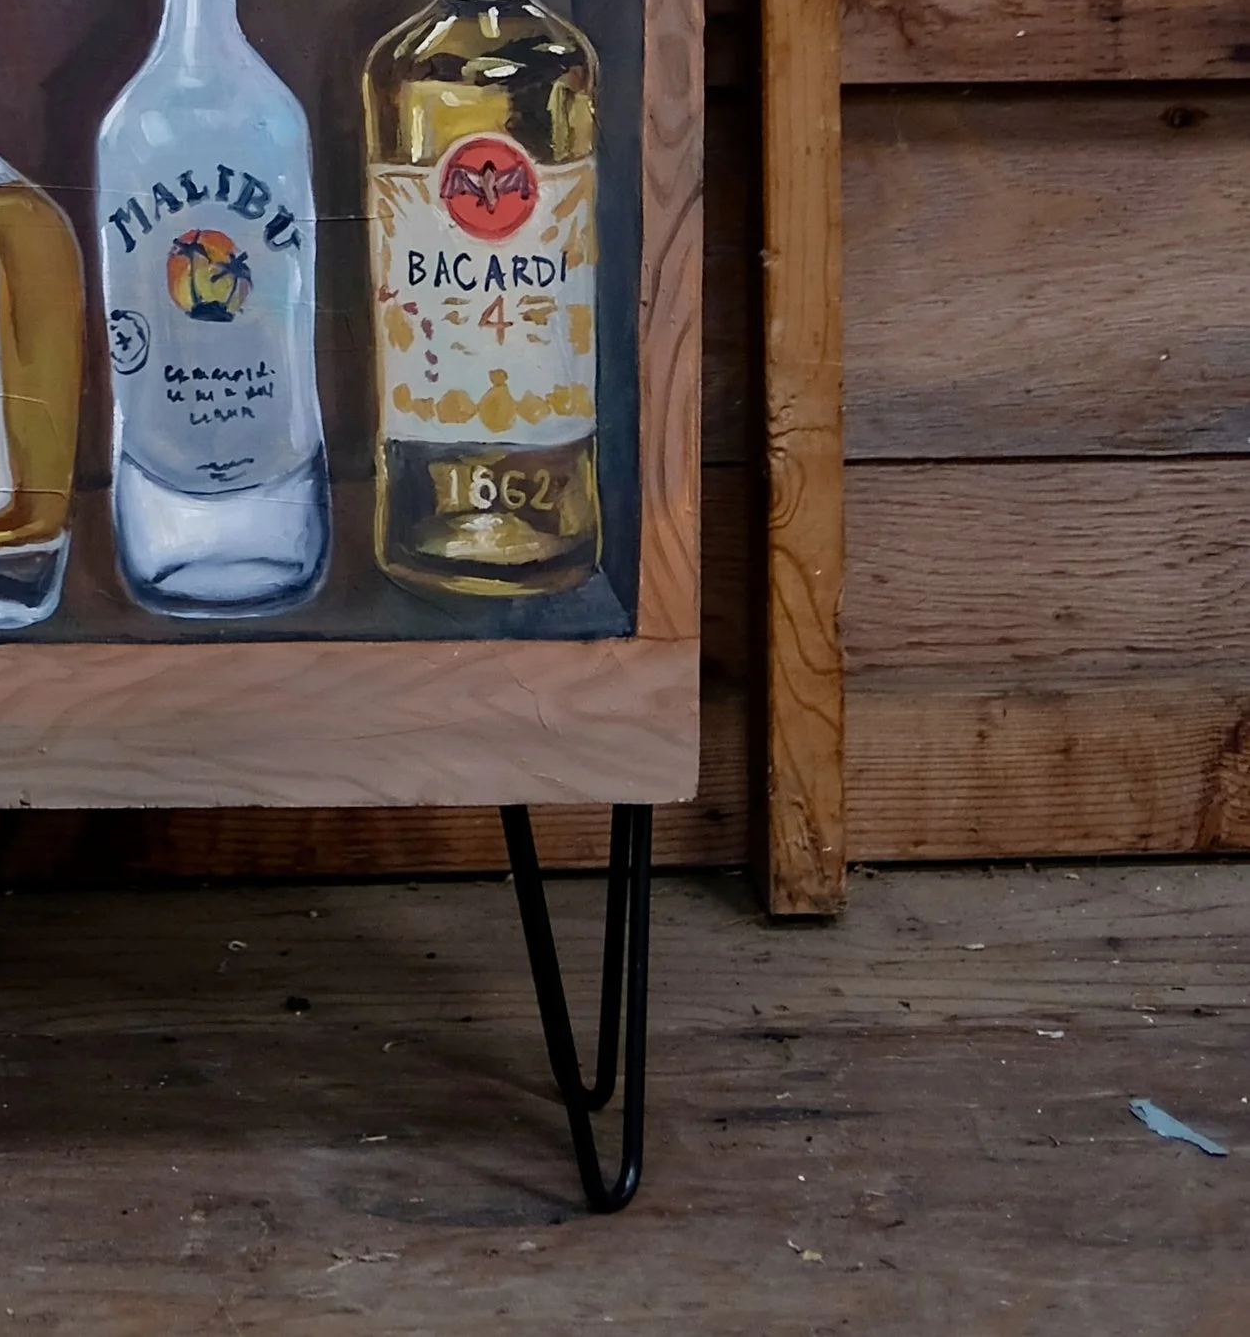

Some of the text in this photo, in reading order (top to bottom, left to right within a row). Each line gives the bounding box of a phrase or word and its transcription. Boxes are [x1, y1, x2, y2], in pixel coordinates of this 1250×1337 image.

[109, 163, 301, 253] MALIBU
[407, 250, 568, 293] BACARDI
[478, 296, 514, 346] 4
[448, 464, 555, 510] 1862
